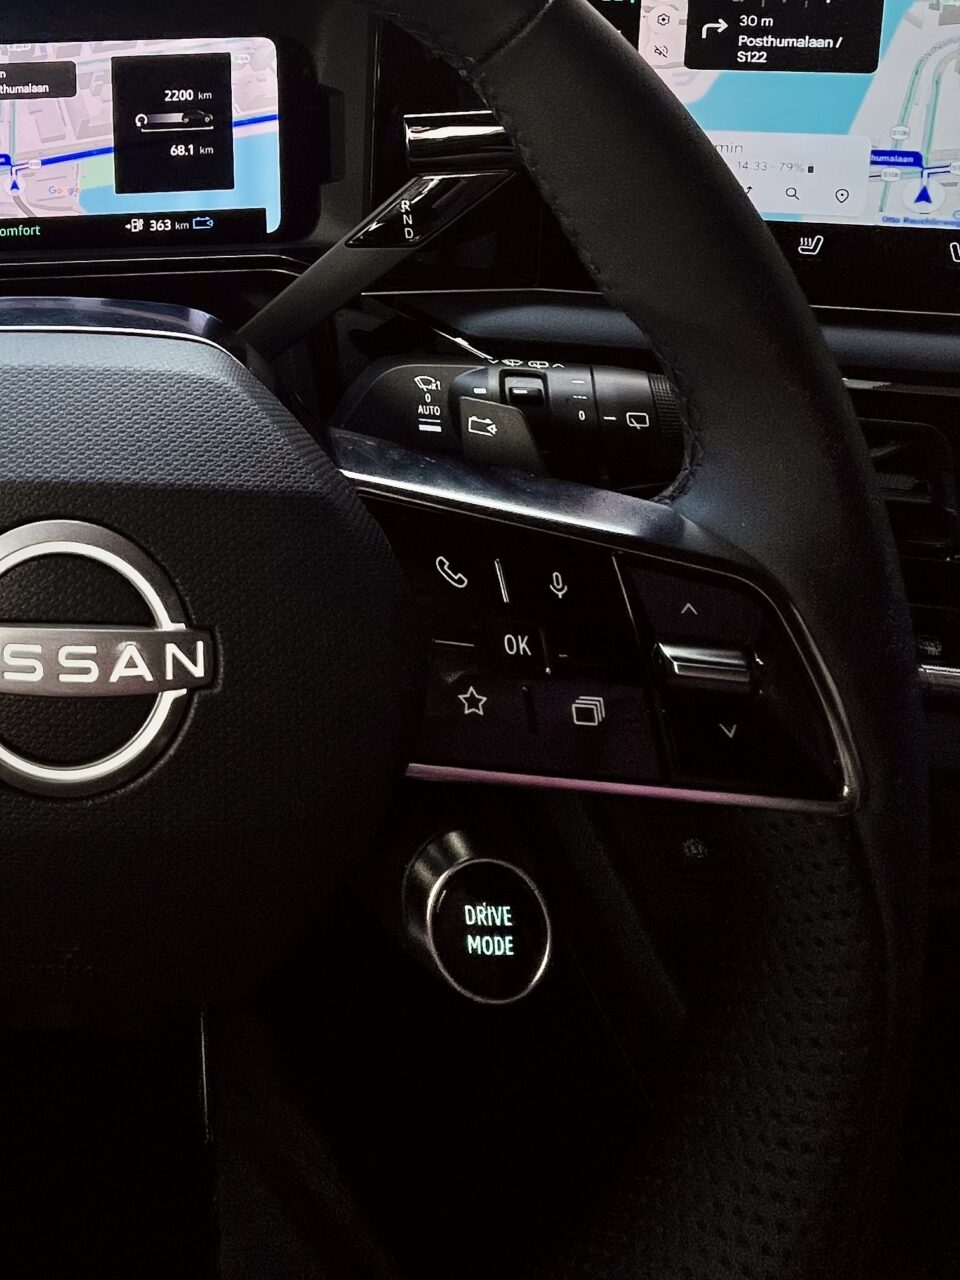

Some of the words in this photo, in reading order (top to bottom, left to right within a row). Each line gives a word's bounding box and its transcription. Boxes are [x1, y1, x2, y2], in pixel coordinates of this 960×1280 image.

[739, 15, 757, 27] 30
[760, 18, 774, 27] m
[738, 35, 834, 49] Posthumalaan
[835, 37, 843, 49] /
[737, 51, 767, 63] S122
[164, 89, 194, 102] 2200
[198, 92, 213, 100] km
[170, 144, 194, 156] 68.1
[199, 146, 214, 155] km
[779, 162, 805, 173] 79%
[400, 200, 411, 213] R
[149, 219, 171, 231] 363
[175, 221, 189, 230] km
[402, 214, 413, 225] N
[404, 227, 414, 239] D
[417, 404, 440, 416] AUTO
[504, 634, 532, 656] OK
[464, 904, 513, 926] DRIVE
[467, 934, 515, 956] MODE
